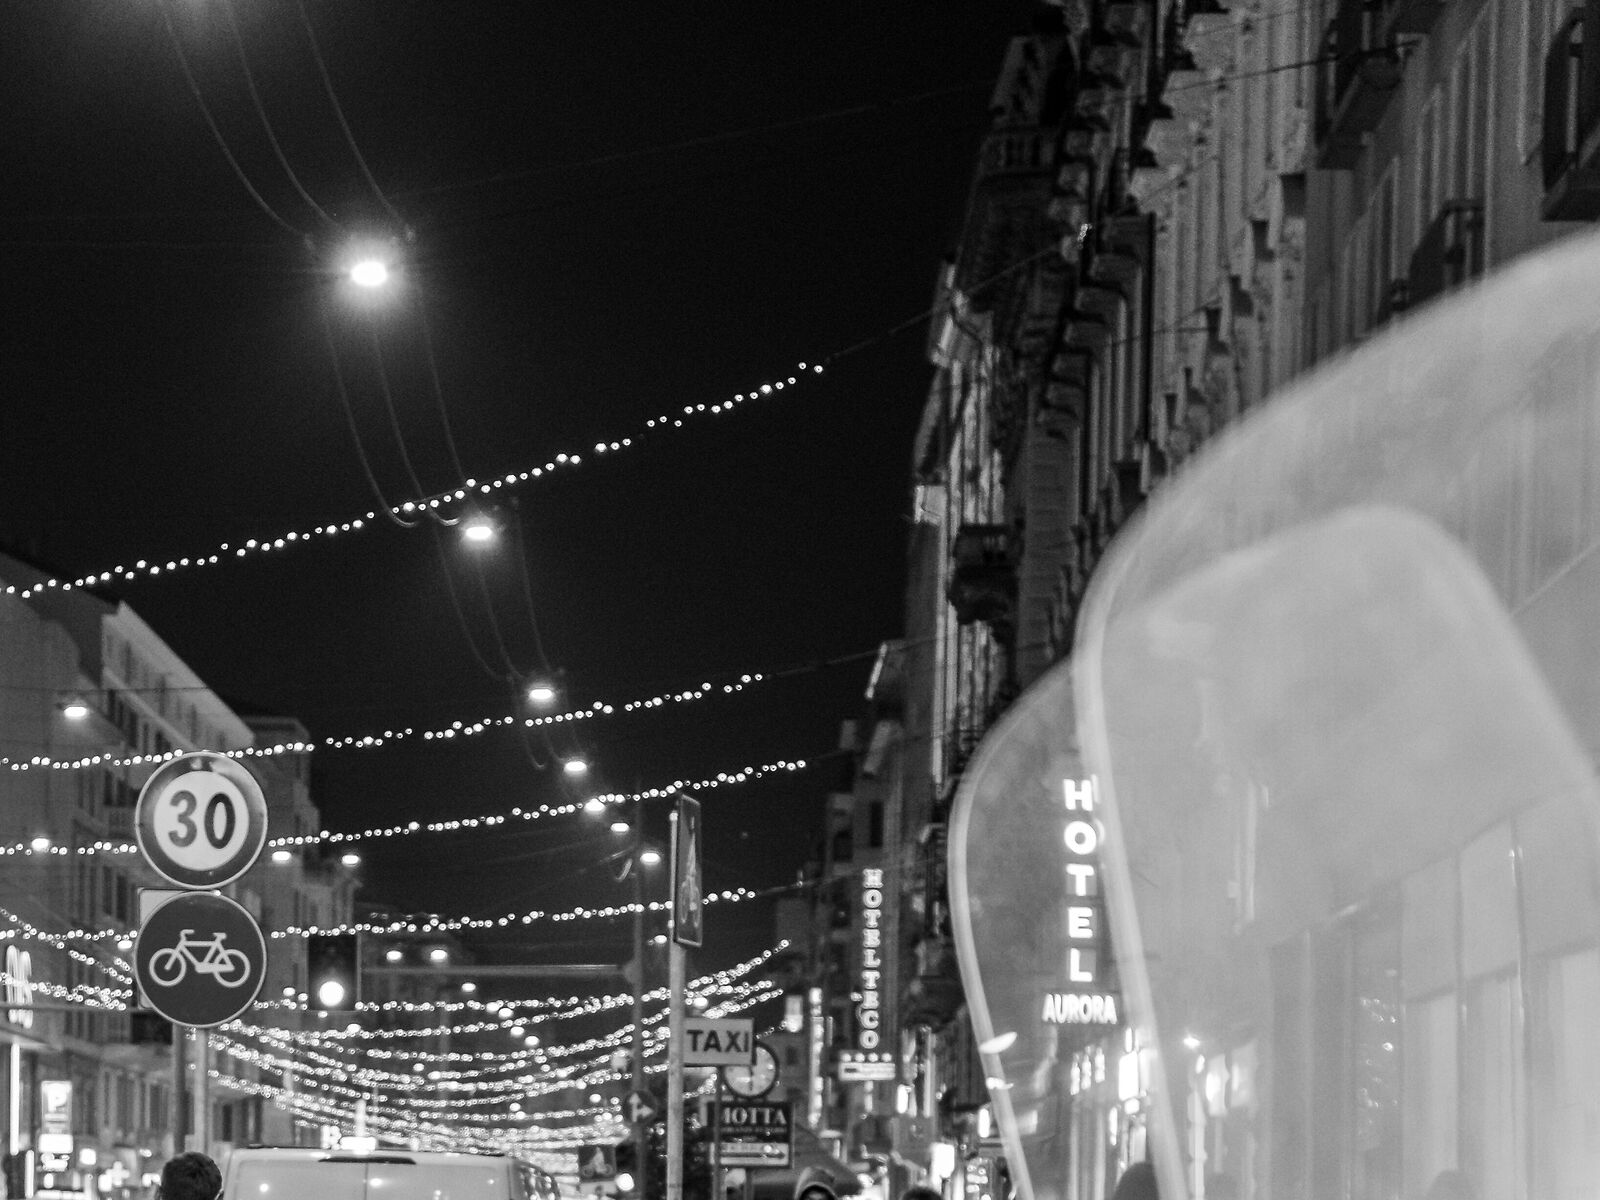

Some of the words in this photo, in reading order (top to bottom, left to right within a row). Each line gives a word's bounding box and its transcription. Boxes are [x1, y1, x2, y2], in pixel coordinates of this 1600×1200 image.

[168, 790, 236, 849] 30
[1063, 778, 1097, 982] HOTEL
[1042, 993, 1118, 1024] AURORA
[686, 1029, 749, 1053] TAXI
